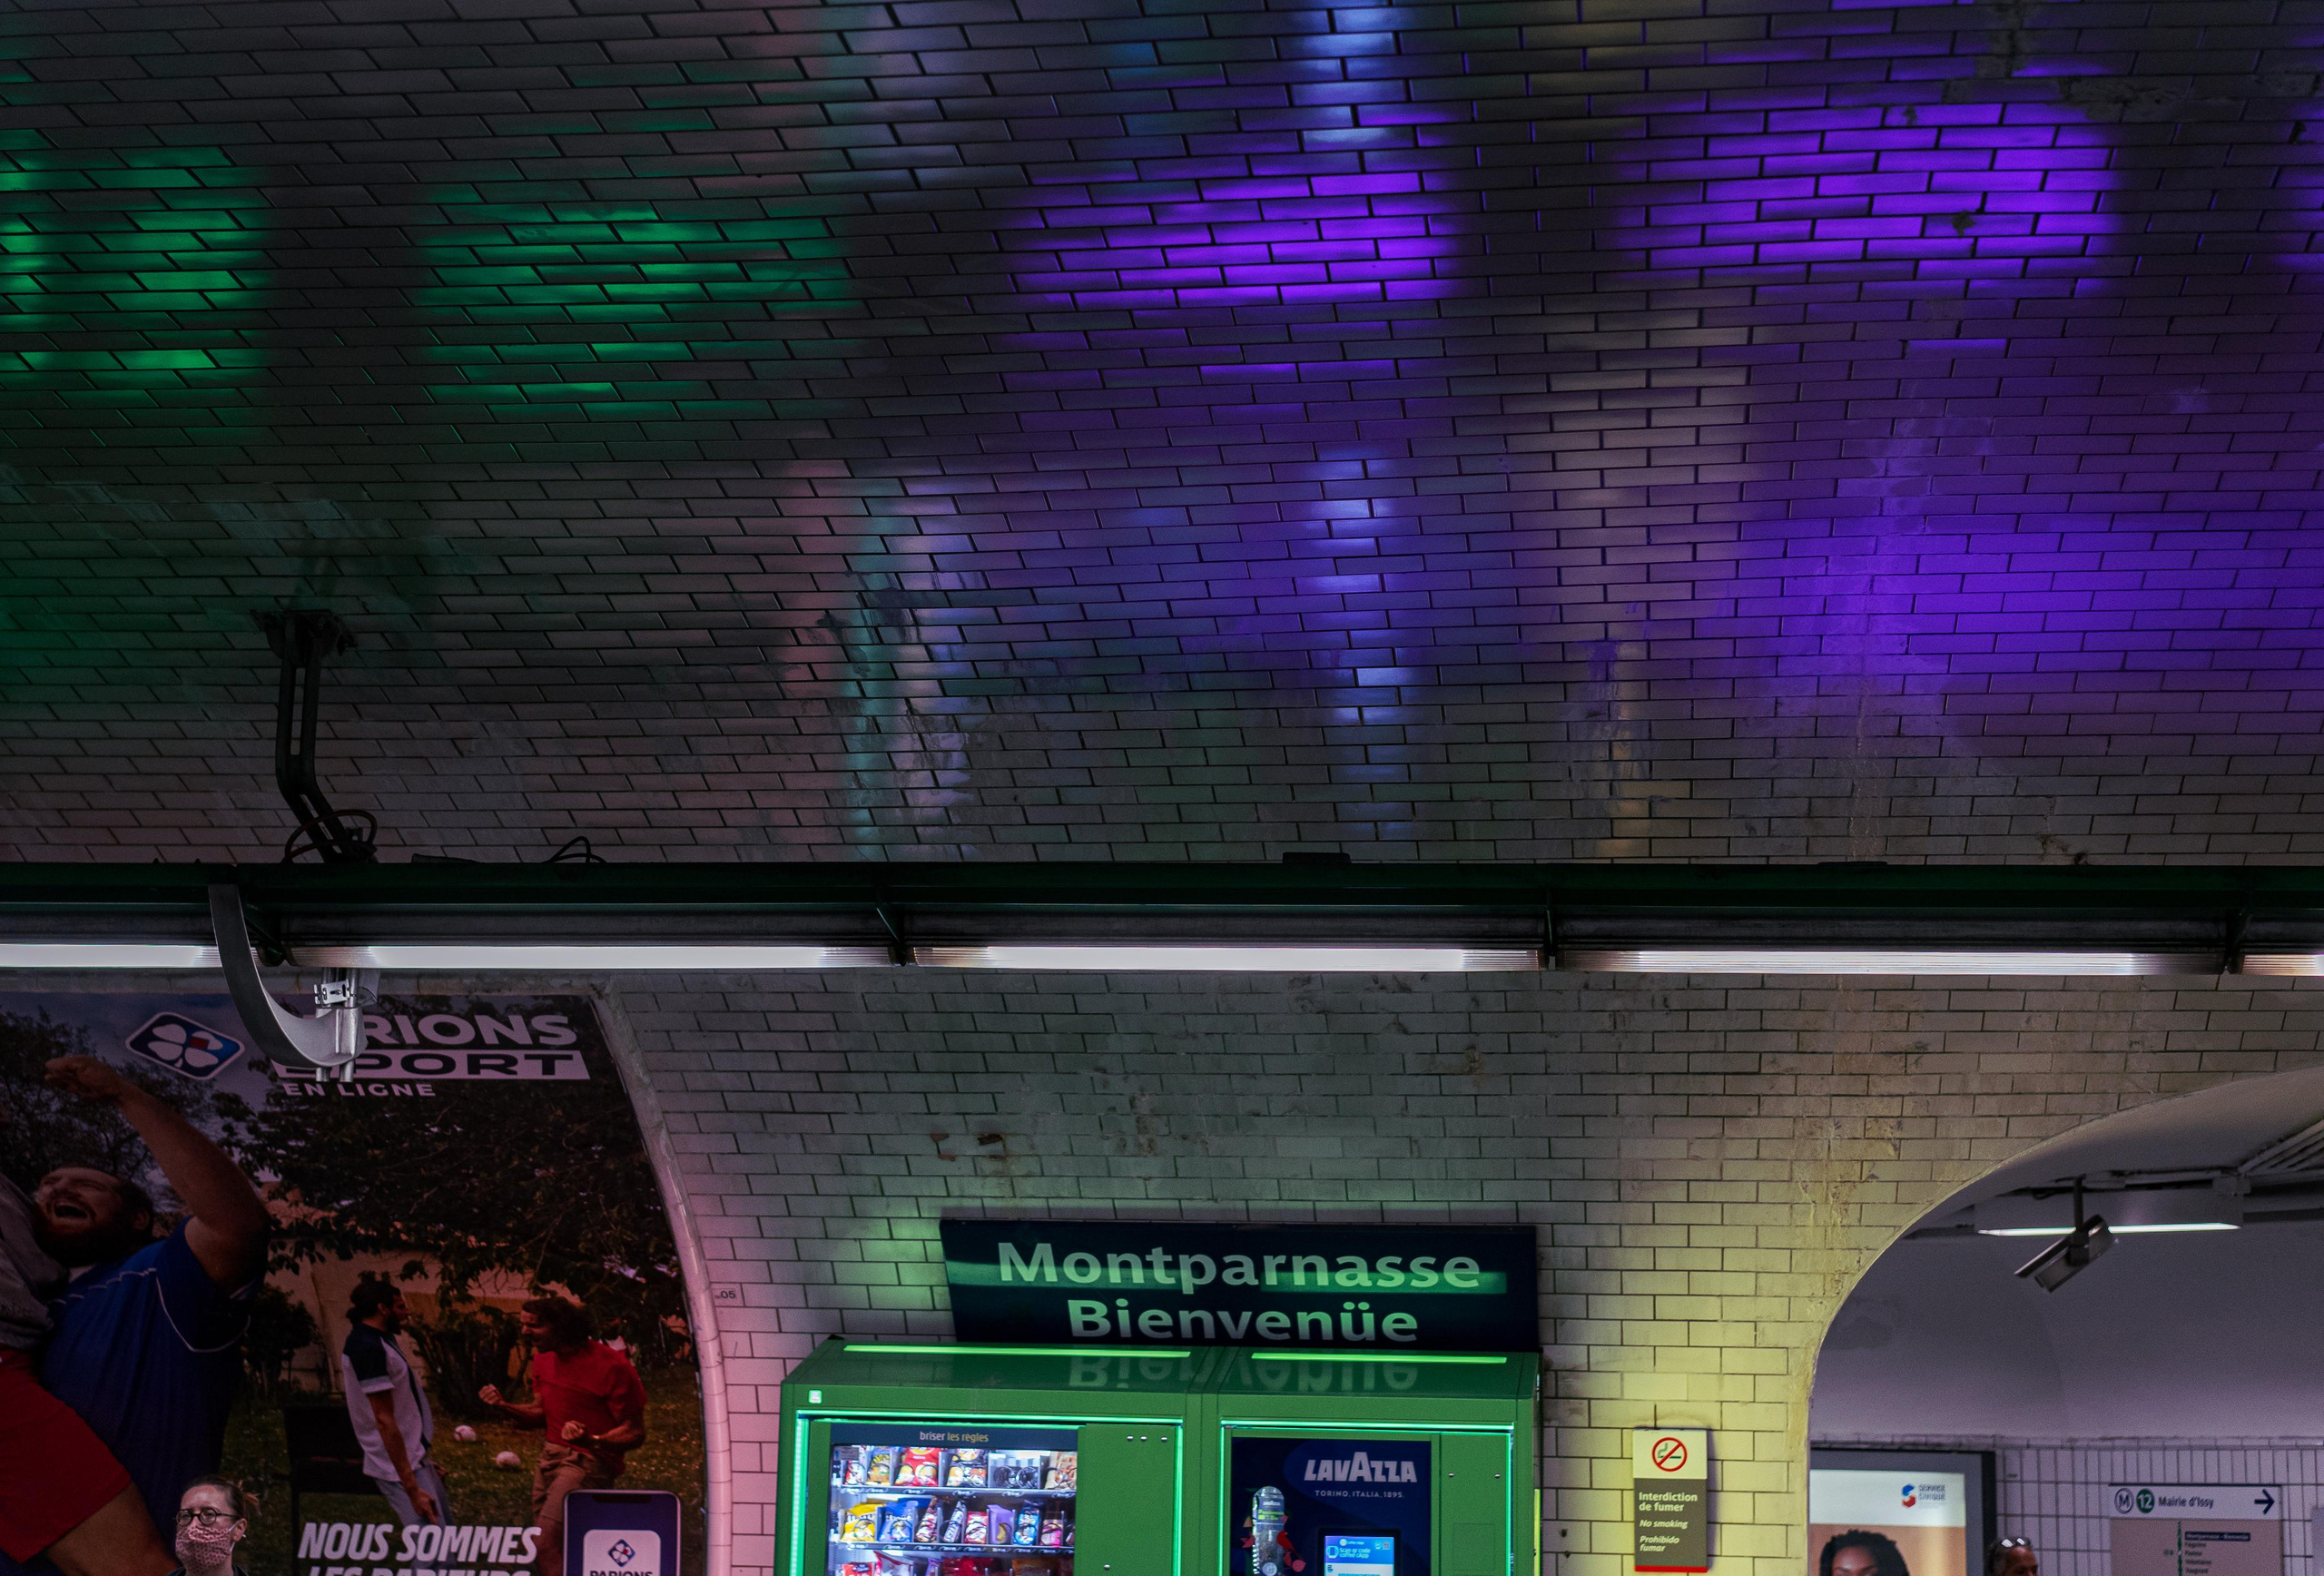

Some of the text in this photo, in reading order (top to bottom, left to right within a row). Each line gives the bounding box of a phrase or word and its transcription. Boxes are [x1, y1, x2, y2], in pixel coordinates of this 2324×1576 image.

[303, 1014, 578, 1045] RIONS
[285, 1052, 575, 1077] PORT
[284, 1083, 437, 1098] EN LIGNE
[998, 1242, 1481, 1295] Montparnasse
[1067, 1298, 1418, 1343] Bienvenüe
[920, 1432, 945, 1440] briser
[947, 1432, 960, 1441] les
[1304, 1452, 1417, 1482] LAVAZZA
[1639, 1492, 1698, 1502] Interdiction
[2138, 1494, 2152, 1510] 12
[2159, 1496, 2186, 1508] Mairie
[1639, 1502, 1684, 1512] de fumer
[1653, 1520, 1688, 1530] smoking
[298, 1522, 542, 1564] NOUS SOMMES
[1640, 1535, 1679, 1543] Prohibido
[1640, 1543, 1665, 1551] fumar
